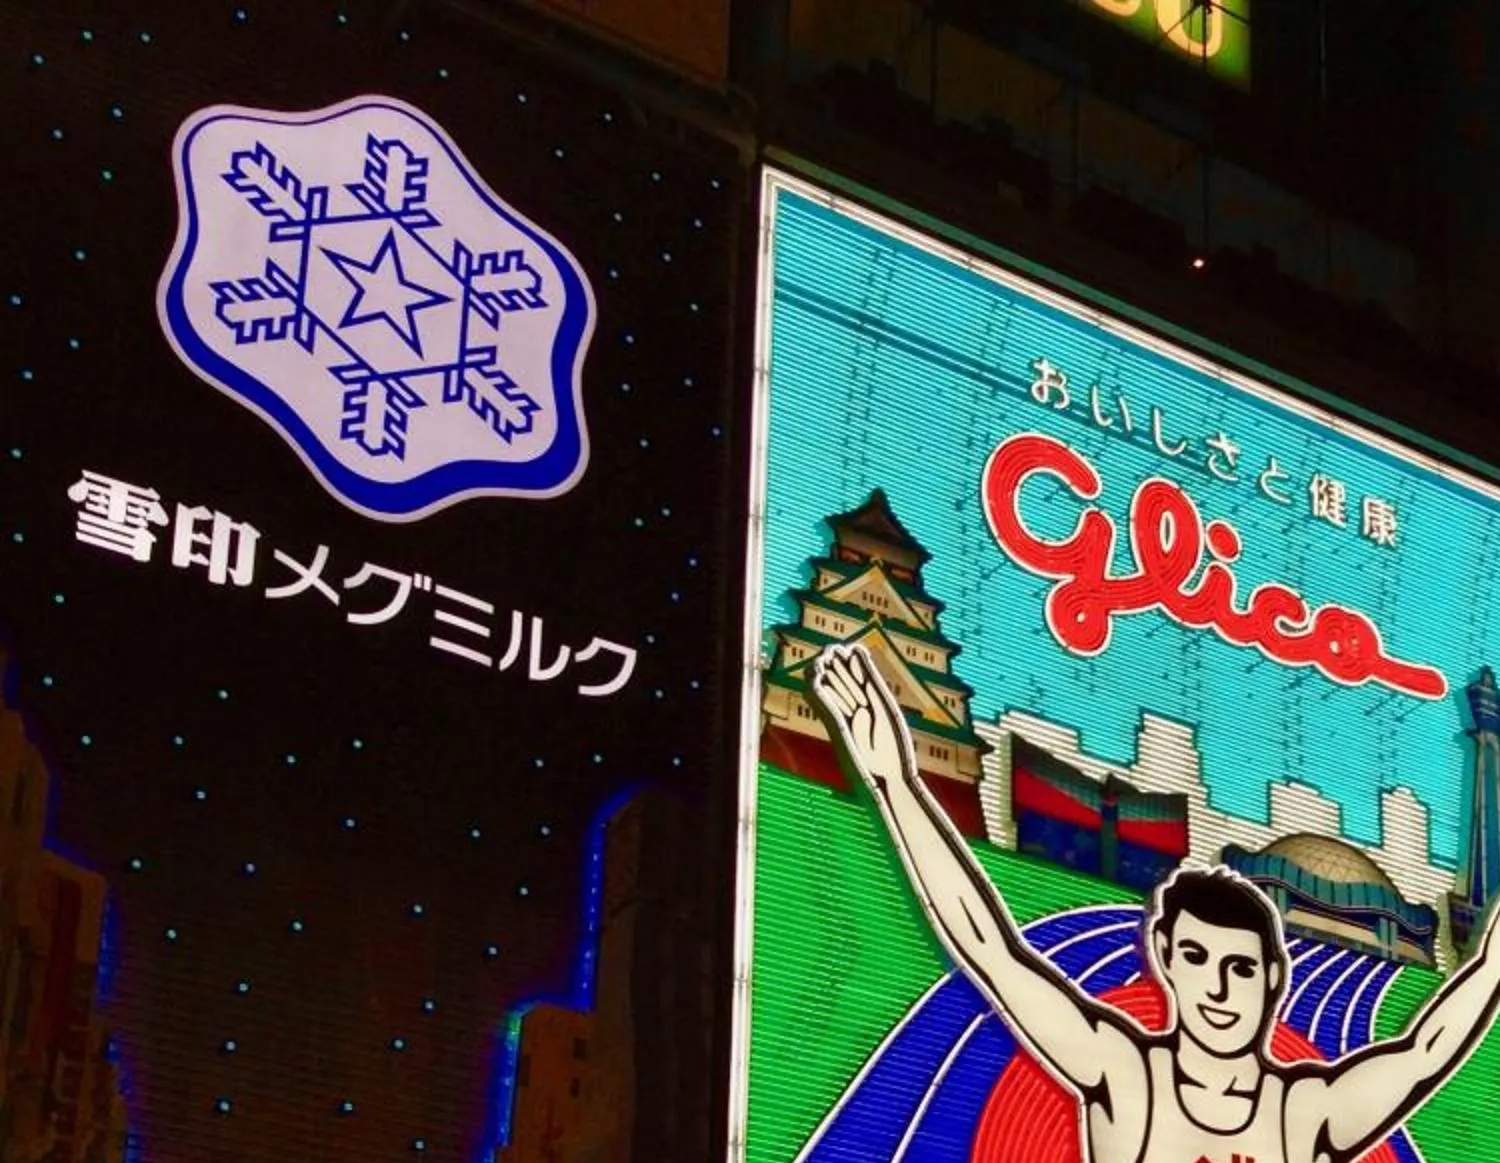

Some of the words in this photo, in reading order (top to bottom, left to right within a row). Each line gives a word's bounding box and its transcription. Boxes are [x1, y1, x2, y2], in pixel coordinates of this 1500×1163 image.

[1030, 356, 1398, 548] おいしさと健康
[67, 470, 638, 697] 雪印メグミルク
